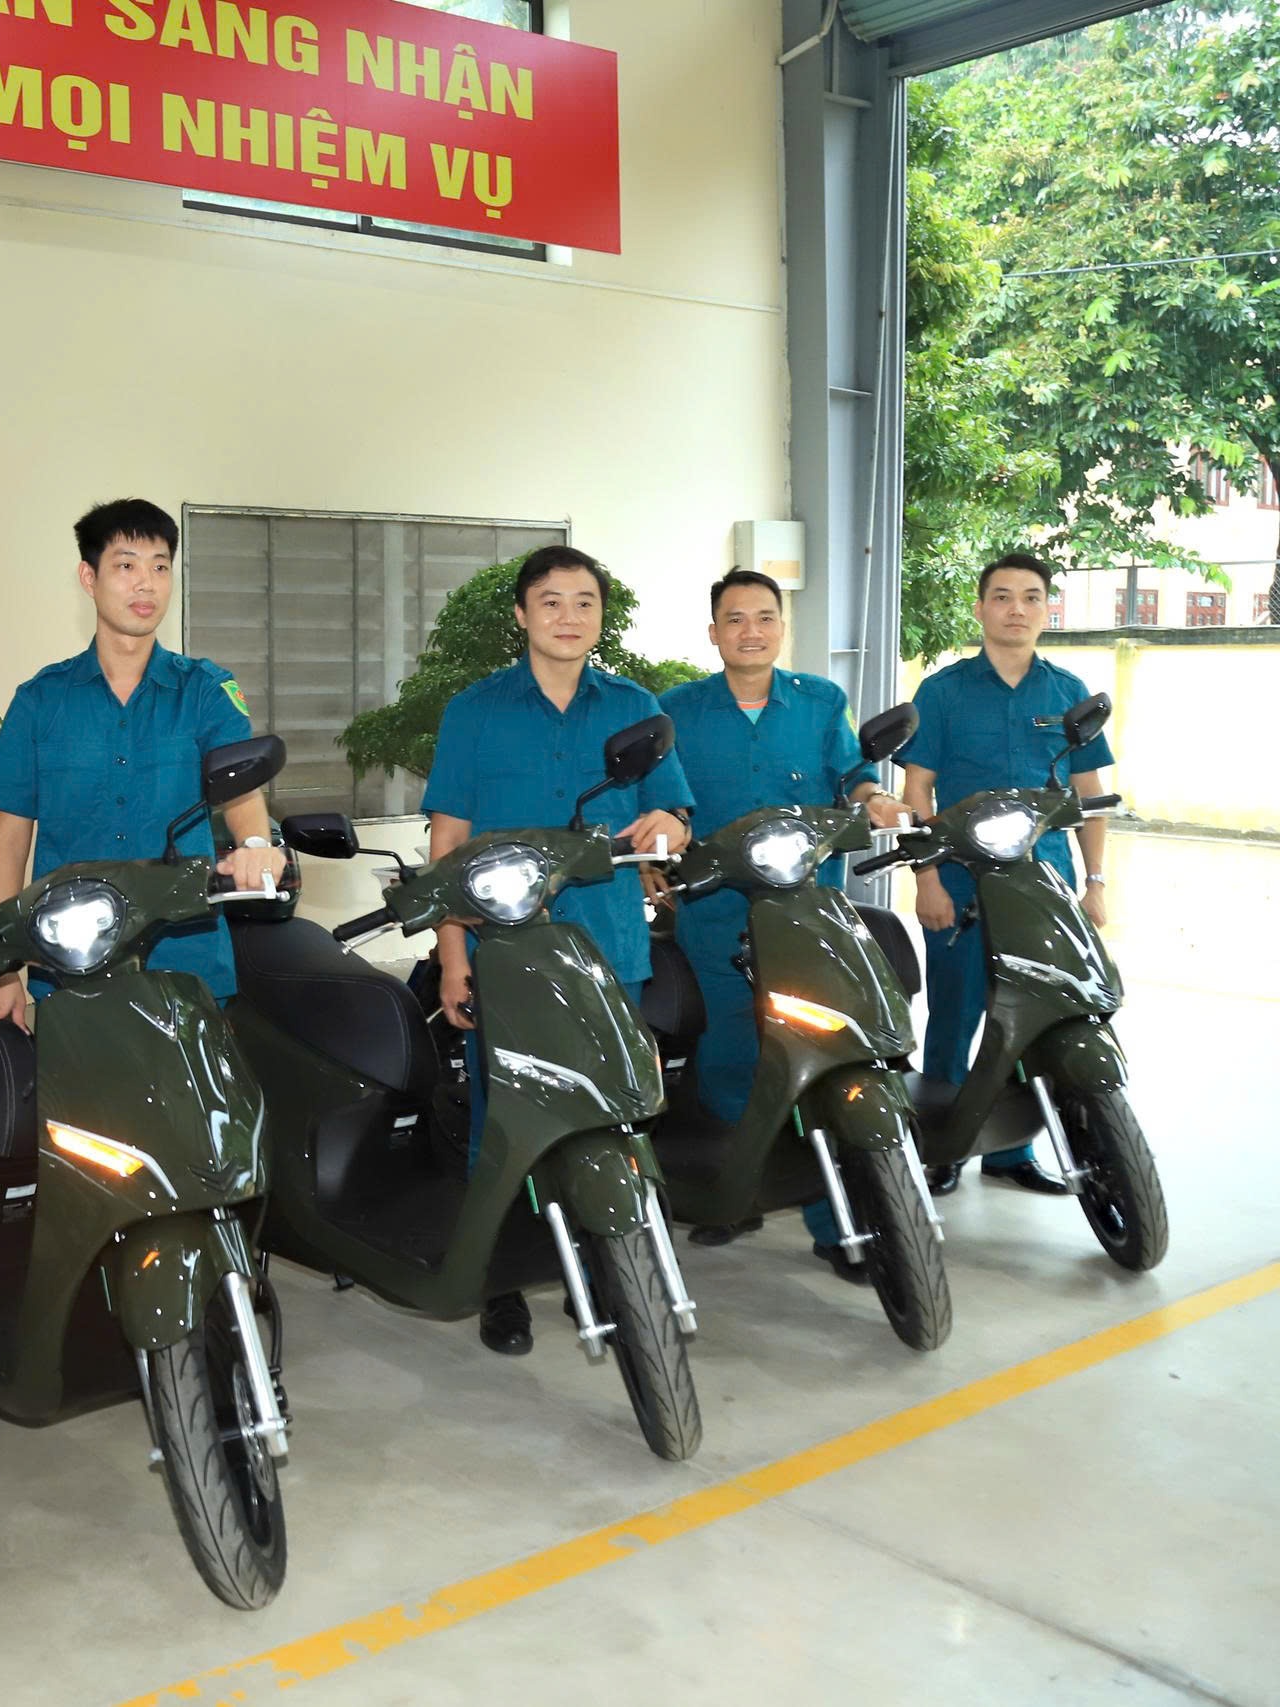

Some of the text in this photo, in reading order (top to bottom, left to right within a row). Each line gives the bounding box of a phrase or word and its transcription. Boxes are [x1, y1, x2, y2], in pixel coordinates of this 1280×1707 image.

[346, 28, 534, 121] NHẬN
[162, 92, 407, 189] NHIỆM
[430, 143, 513, 219] VỤ
